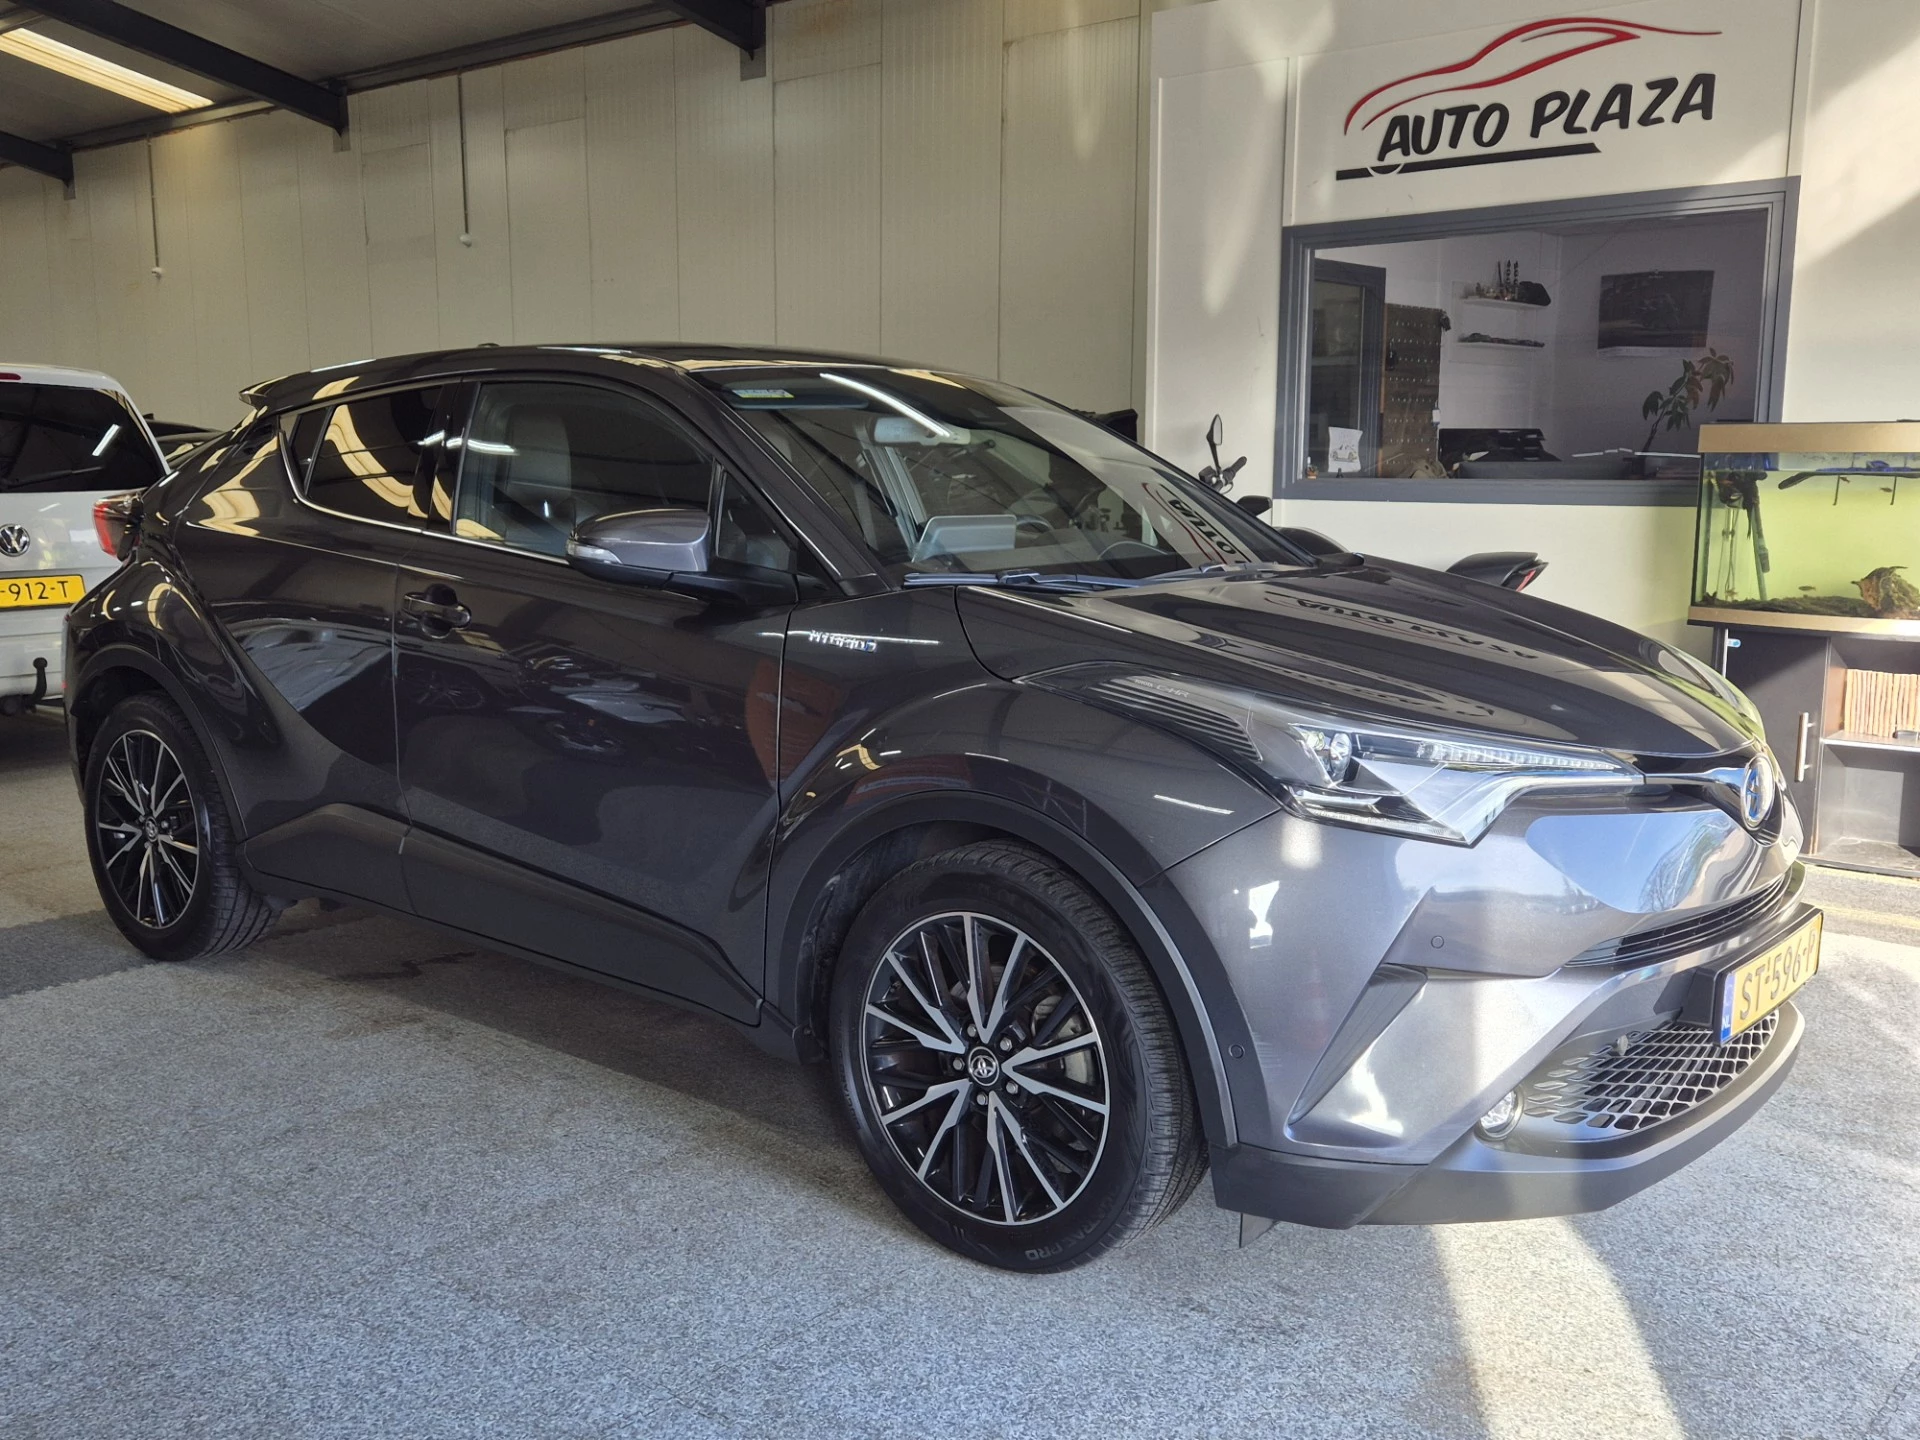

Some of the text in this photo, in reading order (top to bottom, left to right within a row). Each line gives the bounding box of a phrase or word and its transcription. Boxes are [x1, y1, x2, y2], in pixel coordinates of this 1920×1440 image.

[1377, 73, 1716, 162] AUTO PLAZA
[1739, 926, 1817, 1021] ST-596-P
[1025, 1242, 1064, 1261] PRO
